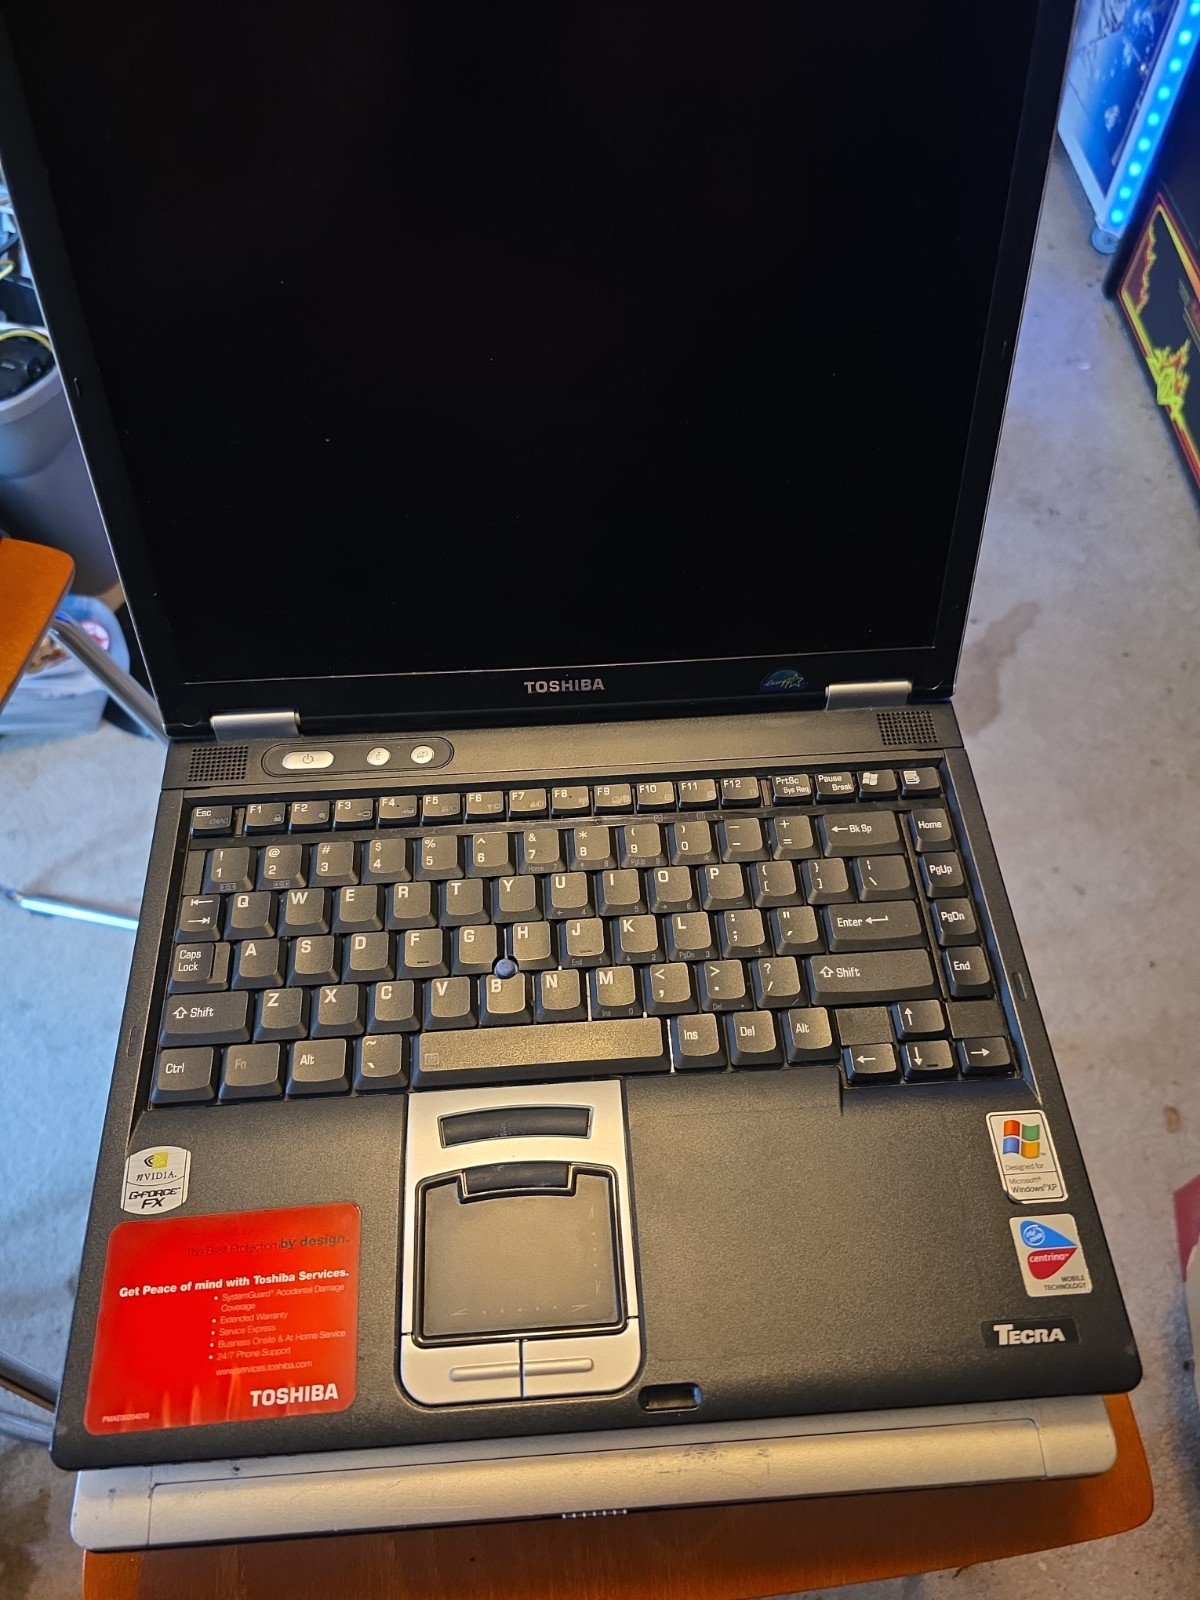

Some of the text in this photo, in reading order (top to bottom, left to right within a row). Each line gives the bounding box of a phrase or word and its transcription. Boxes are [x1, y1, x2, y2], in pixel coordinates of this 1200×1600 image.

[523, 678, 605, 694] TOSHIBA
[723, 780, 741, 788] F12
[776, 777, 799, 785] PrtSc
[818, 775, 842, 783] Pause
[597, 787, 610, 796] F9
[639, 784, 657, 794] F10
[681, 782, 698, 791] F11
[783, 785, 809, 794] Sys Req
[832, 783, 853, 791] Break
[468, 794, 482, 802] F6
[512, 792, 524, 800] F7
[554, 789, 568, 798] F8
[338, 801, 352, 810] F3
[381, 798, 396, 807] F4
[425, 796, 438, 805] F5
[196, 808, 212, 818] Esc
[250, 805, 262, 814] F1
[294, 804, 308, 812] F2
[780, 820, 789, 828] +
[849, 824, 872, 834] Bk Sp
[918, 820, 942, 829] Home
[528, 833, 536, 842] &
[375, 842, 382, 852] $
[424, 839, 436, 848] %
[681, 841, 688, 850] 0
[268, 848, 281, 858] @
[322, 845, 330, 854] #
[580, 847, 587, 856] 8
[630, 844, 638, 854] 9
[477, 853, 485, 862] 6
[529, 850, 536, 859] 7
[373, 859, 382, 868] 4
[426, 856, 433, 866] 5
[268, 865, 277, 874] 2
[320, 862, 329, 872] 3
[929, 865, 952, 875] PgUp
[216, 869, 222, 878] 1
[657, 870, 669, 883] O
[710, 868, 719, 880] P
[555, 876, 566, 888] U
[610, 873, 614, 886] I
[451, 882, 462, 896] T
[503, 879, 514, 892] Y
[346, 889, 355, 902] E
[398, 886, 409, 898] R
[237, 896, 249, 908] Q
[290, 891, 308, 905] W
[837, 917, 863, 927] Enter
[941, 911, 965, 923] PgDn
[623, 919, 635, 933] K
[677, 916, 687, 930] L
[517, 926, 529, 939] H
[572, 923, 581, 936] J
[410, 933, 420, 946] F
[463, 929, 475, 943] G
[300, 940, 312, 953] S
[355, 936, 366, 950] D
[245, 942, 257, 956] A
[179, 950, 202, 960] Caps
[679, 951, 695, 959] PgDn
[178, 962, 199, 972] Lock
[571, 958, 583, 966] End
[954, 961, 971, 971] End
[836, 968, 860, 978] Shift
[545, 974, 558, 988] N
[599, 972, 614, 985] M
[436, 981, 448, 996] V
[491, 979, 502, 993] B
[324, 988, 338, 1003] X
[380, 985, 392, 1000] C
[267, 993, 280, 1007] Z
[190, 1007, 214, 1018] Shift
[740, 1026, 756, 1037] Del
[795, 1023, 810, 1033] Alt
[684, 1030, 698, 1040] Ins
[234, 1059, 247, 1070] Fn
[300, 1054, 315, 1065] Alt
[165, 1062, 185, 1074] Ctrl
[1004, 1163, 1034, 1171] Designed
[141, 1197, 166, 1209] FX
[206, 1246, 228, 1255] Best
[230, 1241, 277, 1253] Protection
[280, 1237, 296, 1249] by
[300, 1234, 349, 1247] design.
[1029, 1252, 1065, 1263] centrino
[119, 1268, 349, 1298] Get Peace of mind with Toshiba Services.
[1043, 1282, 1086, 1291] TECHNOLOGY
[276, 1286, 313, 1297] Accidental
[314, 1284, 345, 1293] Damage
[221, 1303, 256, 1313] Coverage
[220, 1311, 288, 1325] Extended Warranty
[219, 1325, 276, 1337] Service Express
[993, 1324, 1066, 1346] TECRA
[217, 1338, 251, 1348] Business
[252, 1335, 276, 1345] Onsite
[285, 1334, 294, 1342] At
[295, 1333, 318, 1341] Home
[319, 1330, 346, 1339] Service
[217, 1347, 291, 1361] 24/7 Phone Support
[249, 1382, 339, 1407] TOSHIBA
